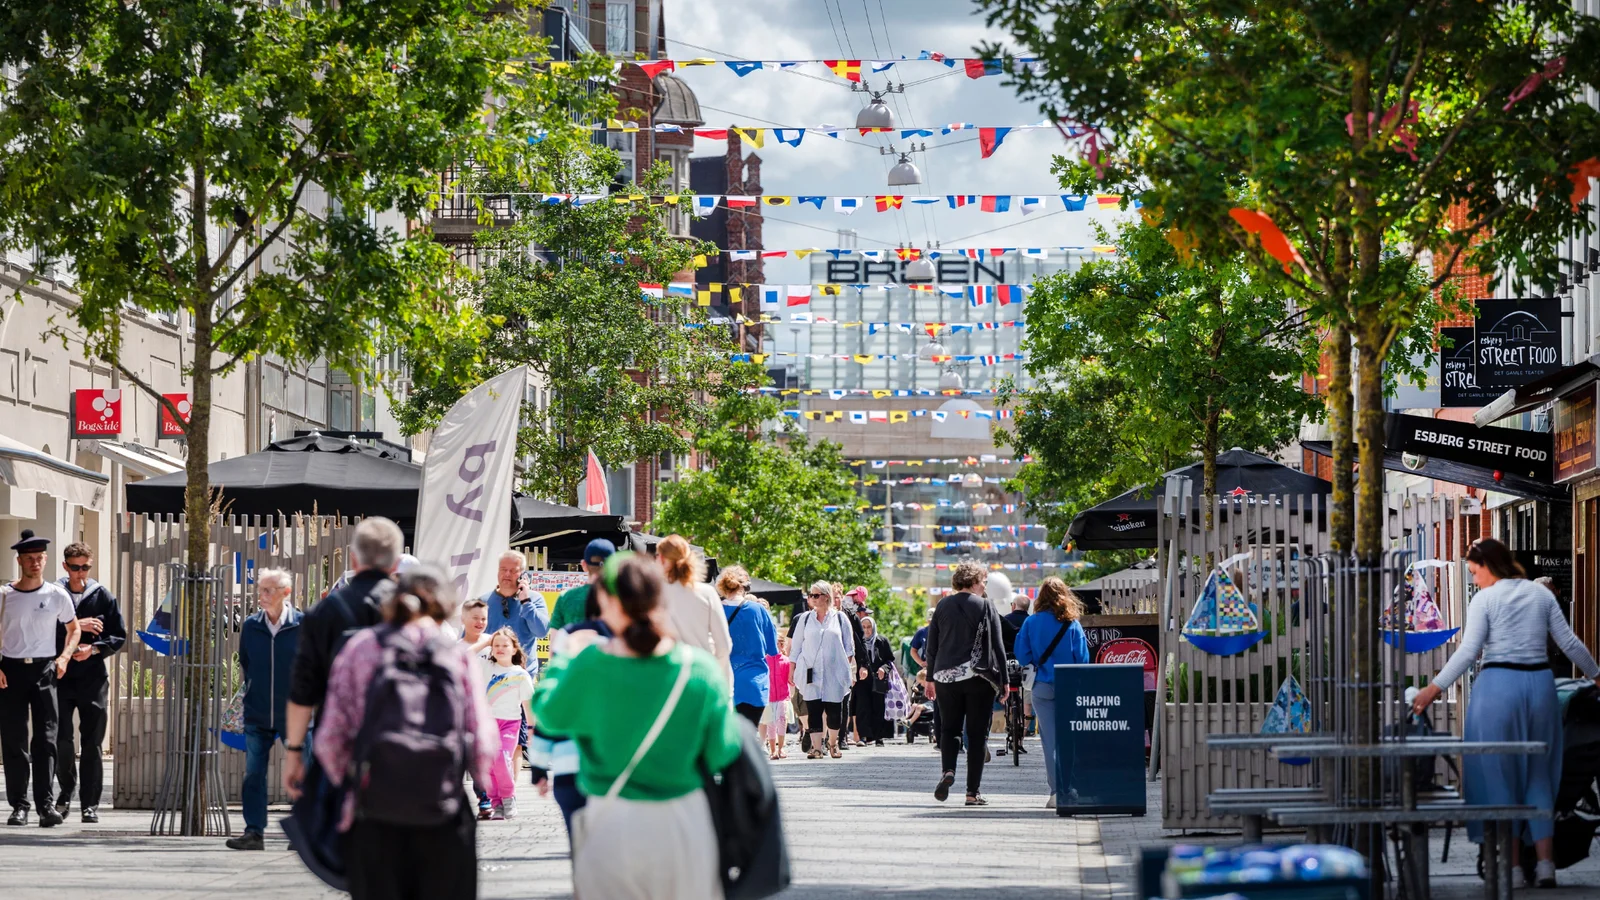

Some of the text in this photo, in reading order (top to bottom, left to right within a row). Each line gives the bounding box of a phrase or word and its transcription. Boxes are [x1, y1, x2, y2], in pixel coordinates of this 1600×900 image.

[1529, 346, 1557, 366] FOOD
[78, 420, 119, 432] Bog&idé
[1414, 429, 1547, 462] ESBJERG STREET FOOD
[446, 440, 497, 522] by
[1104, 649, 1148, 665] Coca-Cola
[1076, 695, 1121, 706] SHAPING
[1086, 708, 1108, 718] NEW
